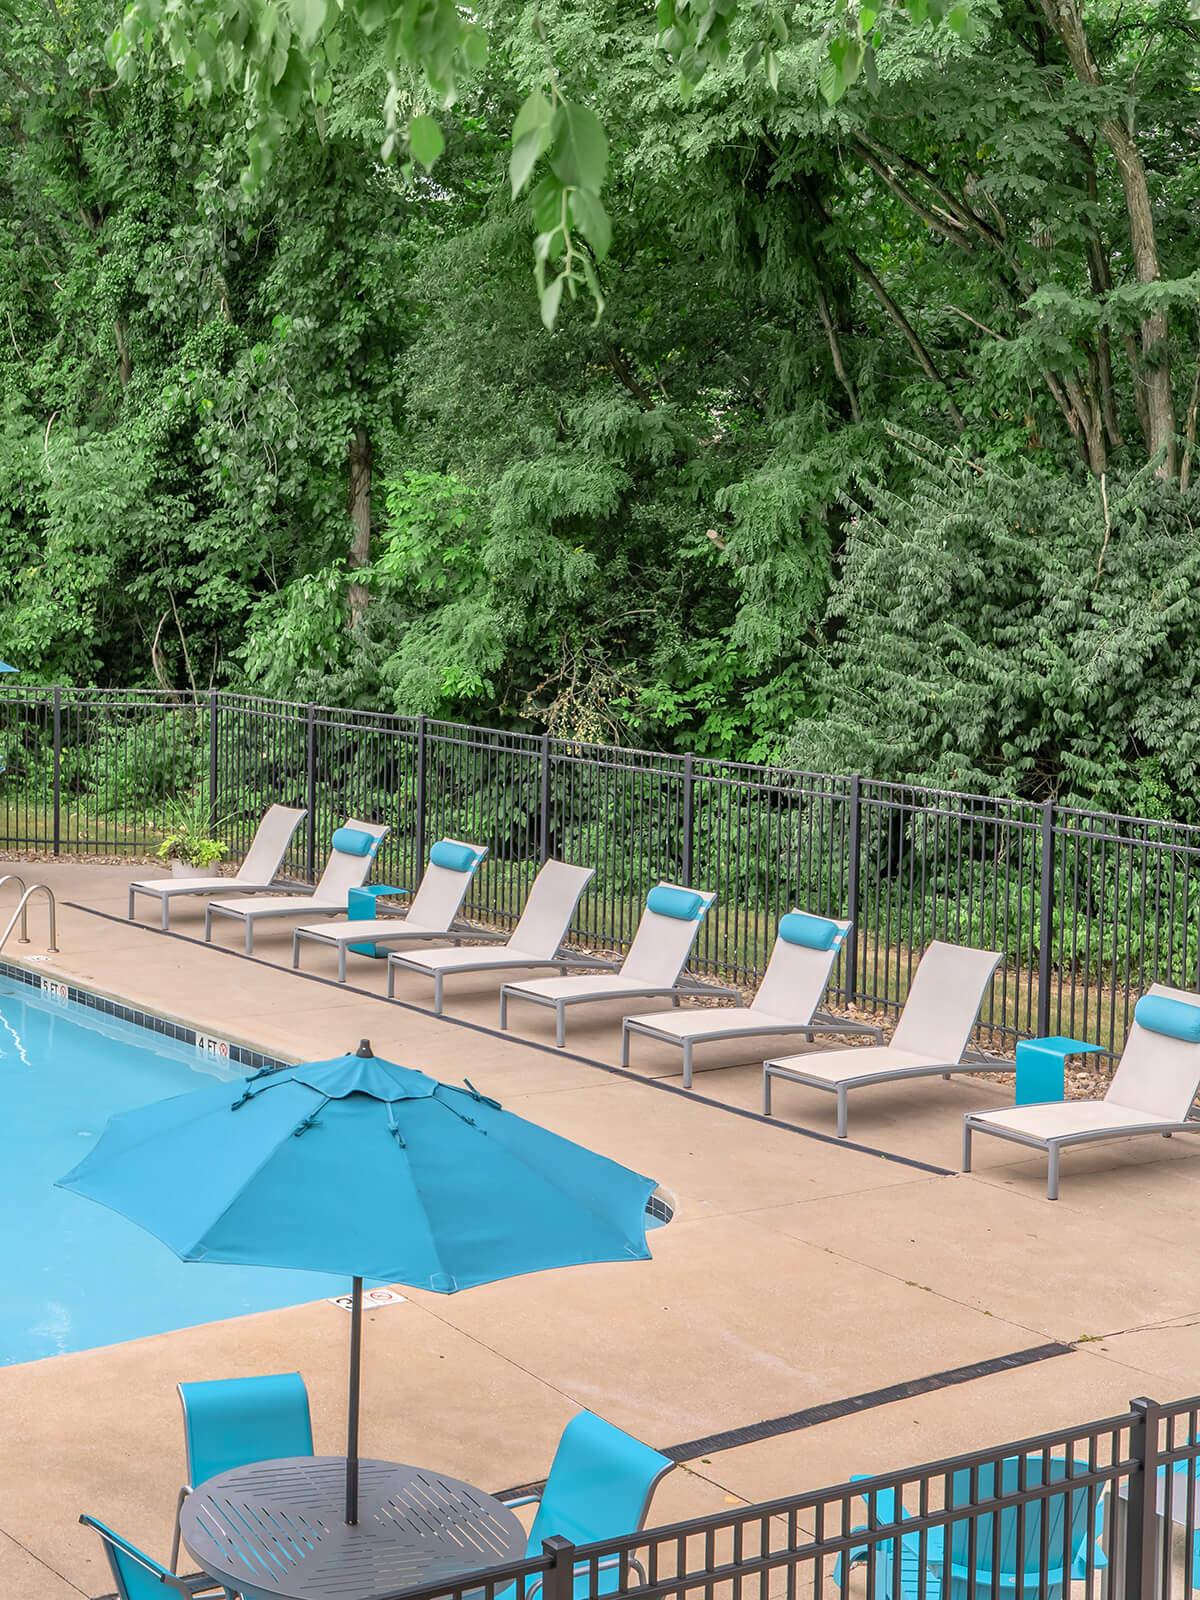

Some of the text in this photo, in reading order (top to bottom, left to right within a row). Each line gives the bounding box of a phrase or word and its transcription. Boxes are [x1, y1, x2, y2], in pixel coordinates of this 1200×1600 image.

[43, 980, 58, 994] 5 FT
[199, 1037, 217, 1056] 4 FT
